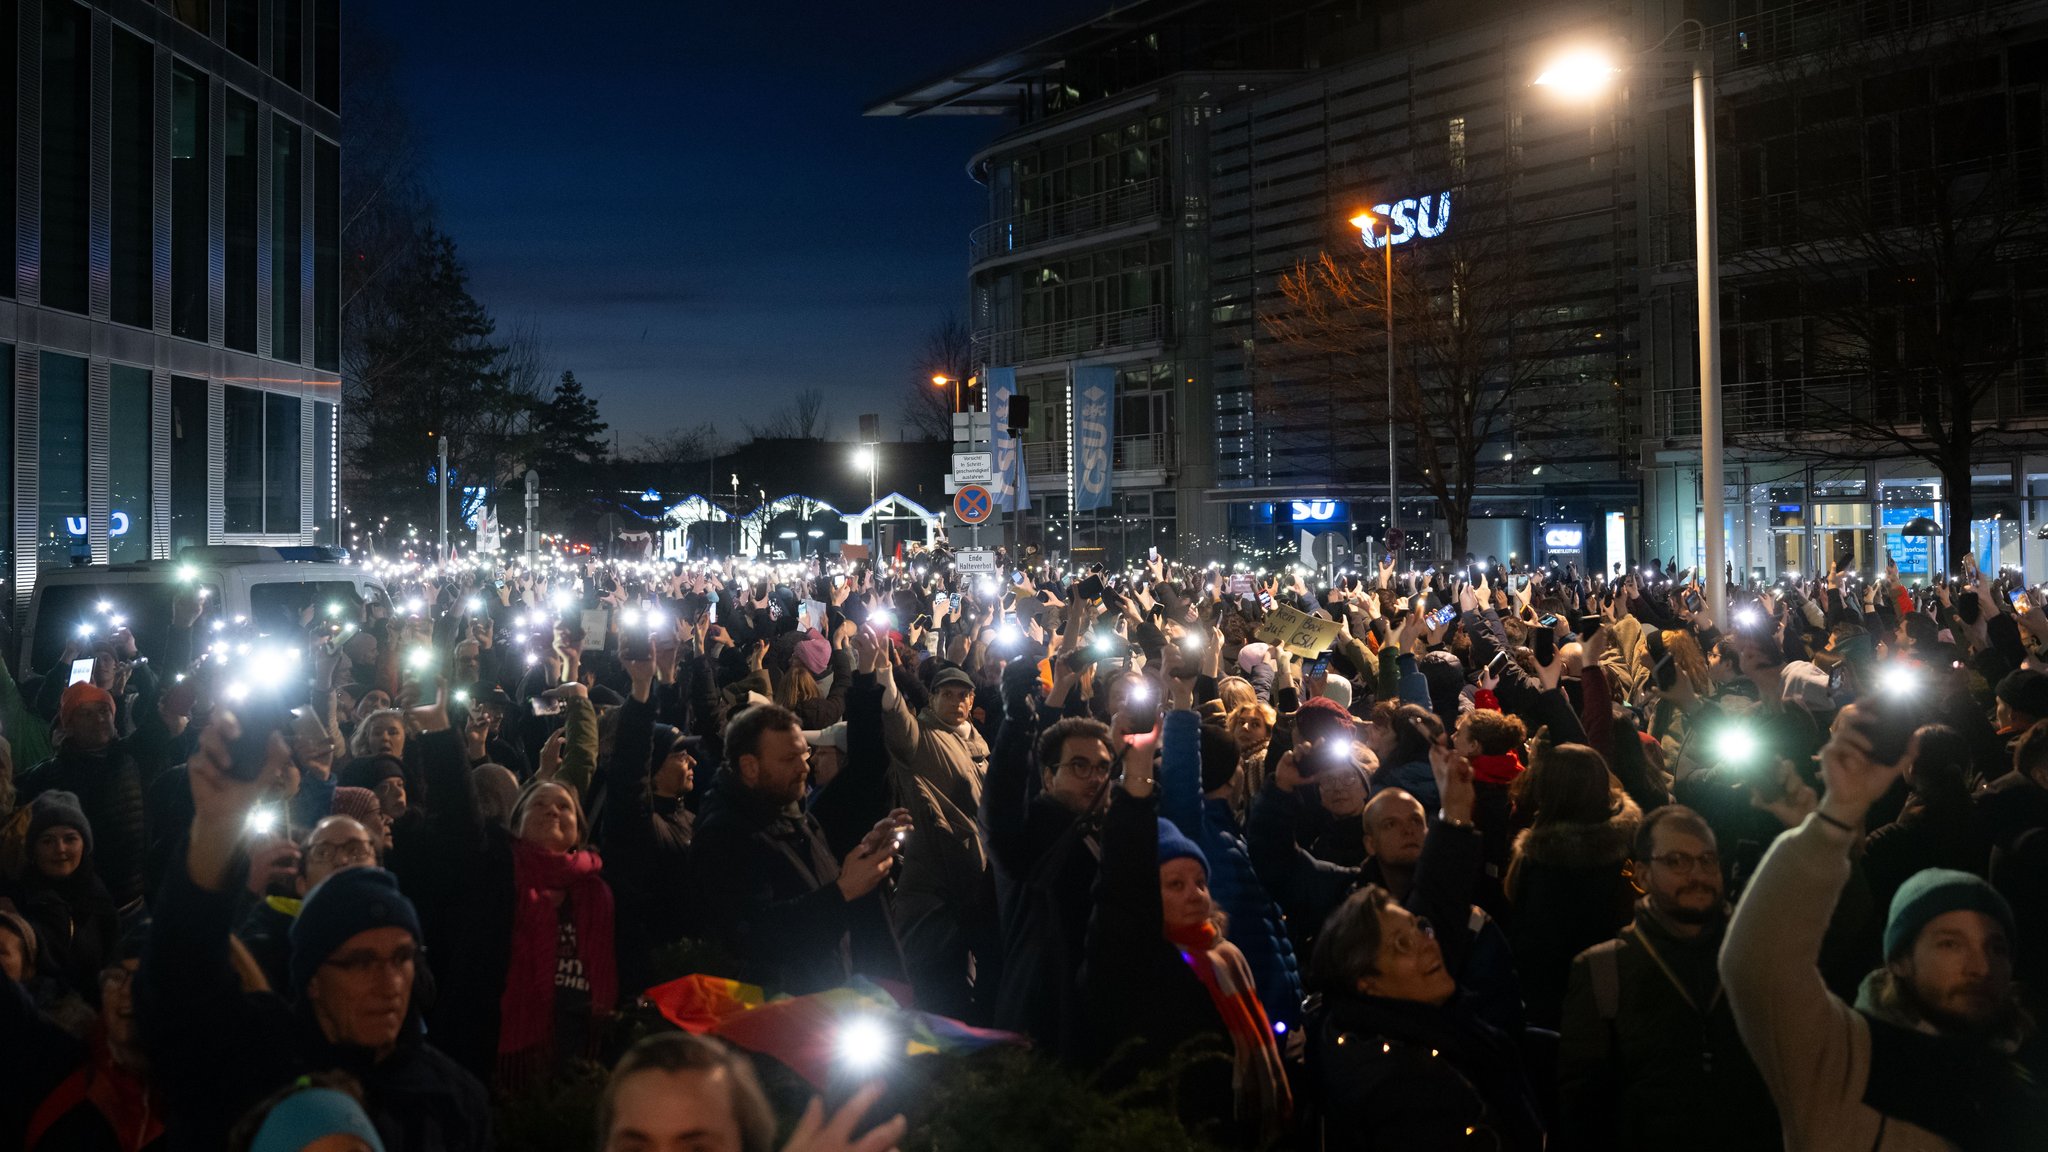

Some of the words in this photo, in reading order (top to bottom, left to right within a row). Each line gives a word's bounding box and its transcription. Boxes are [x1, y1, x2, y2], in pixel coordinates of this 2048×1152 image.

[1361, 191, 1450, 249] CSU
[1082, 420, 1107, 494] CSU
[1270, 499, 1336, 521] SU
[1545, 530, 1582, 547] CSU
[960, 562, 992, 570] Halteverbot
[1263, 622, 1286, 637] auf
[1291, 631, 1318, 650] CSU
